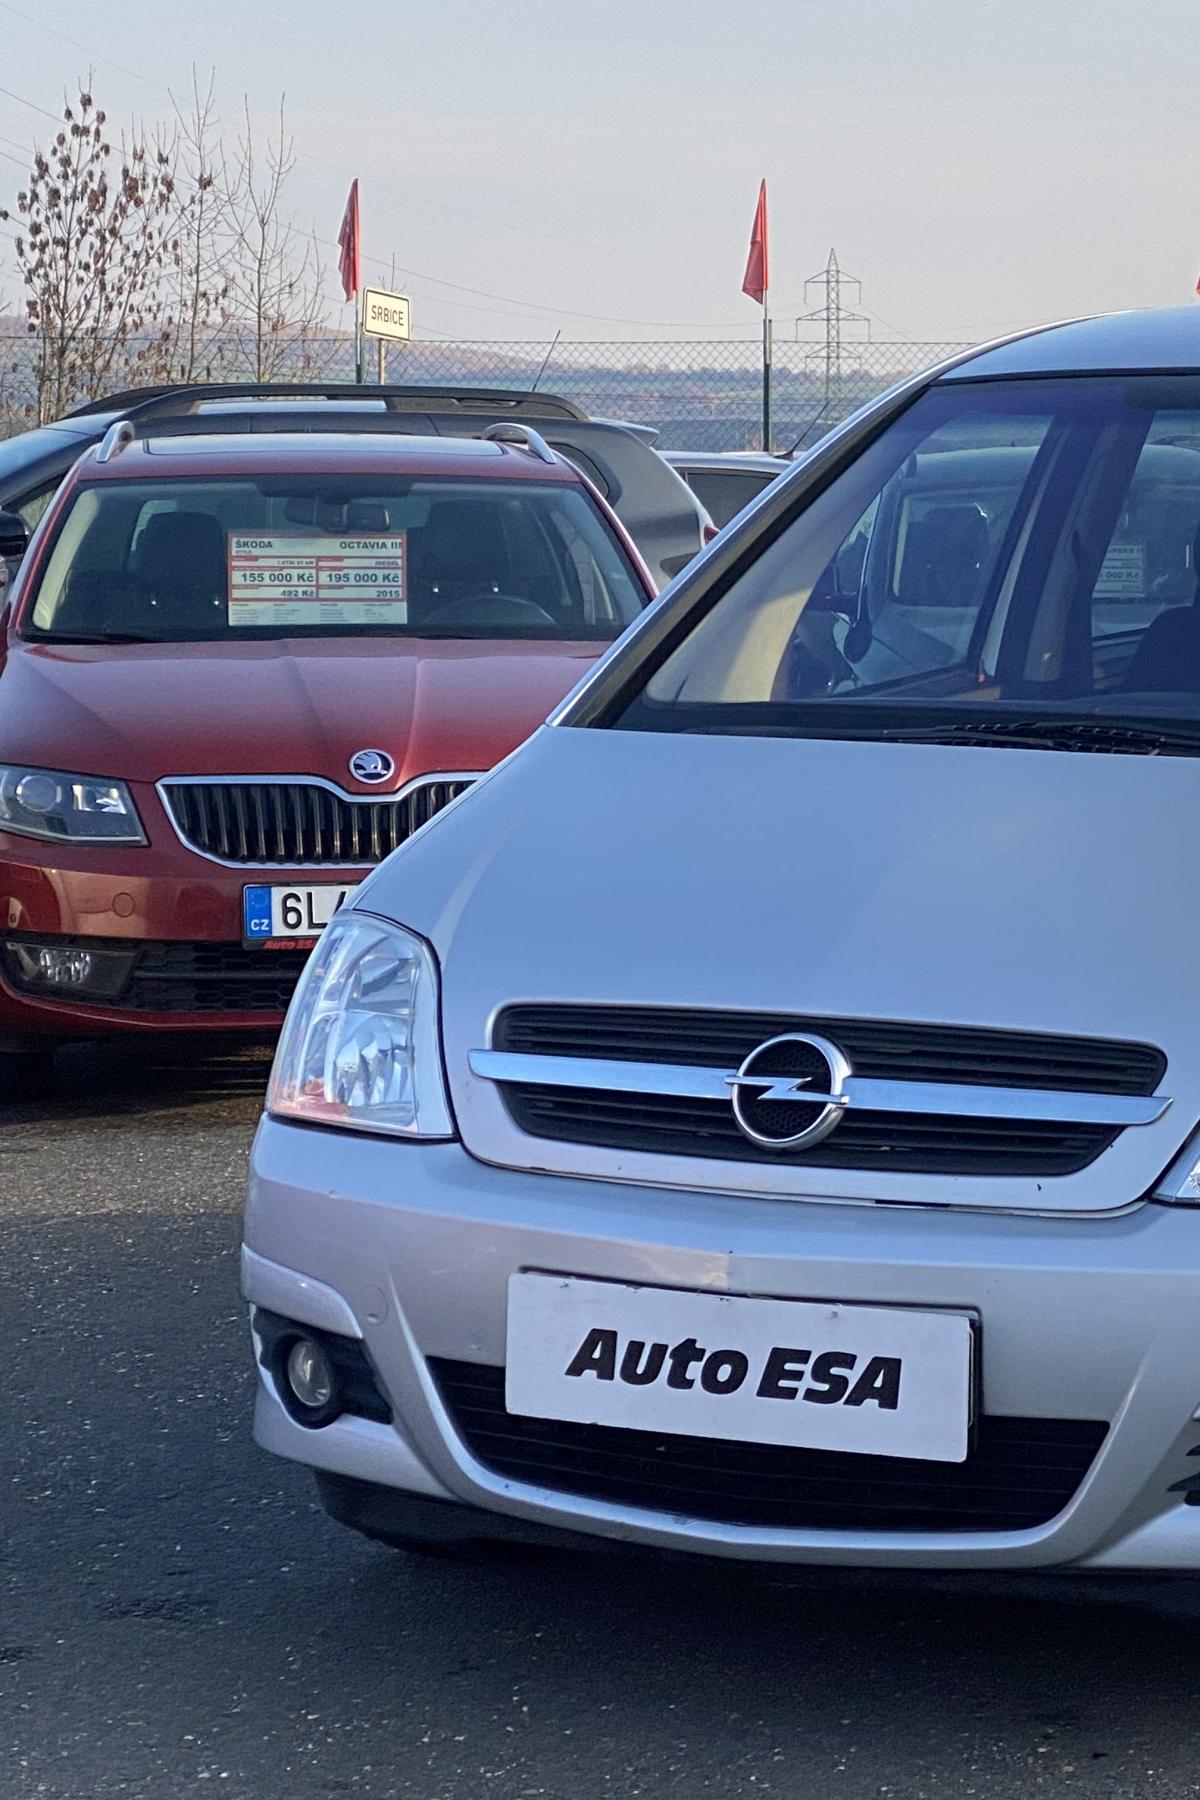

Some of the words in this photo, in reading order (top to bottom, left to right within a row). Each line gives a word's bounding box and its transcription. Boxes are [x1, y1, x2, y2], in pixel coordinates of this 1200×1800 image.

[371, 305, 404, 326] SRBICE
[235, 539, 273, 549] ŠKODA
[340, 541, 387, 549] OCTAVIA
[241, 573, 264, 582] 155
[269, 573, 292, 582] 000
[297, 572, 314, 582] Kč
[327, 573, 350, 582] 195
[354, 573, 378, 583] 000
[382, 573, 399, 583] Kč
[250, 919, 270, 931] CZ
[564, 1328, 748, 1395] Auto
[756, 1346, 903, 1411] ESA
